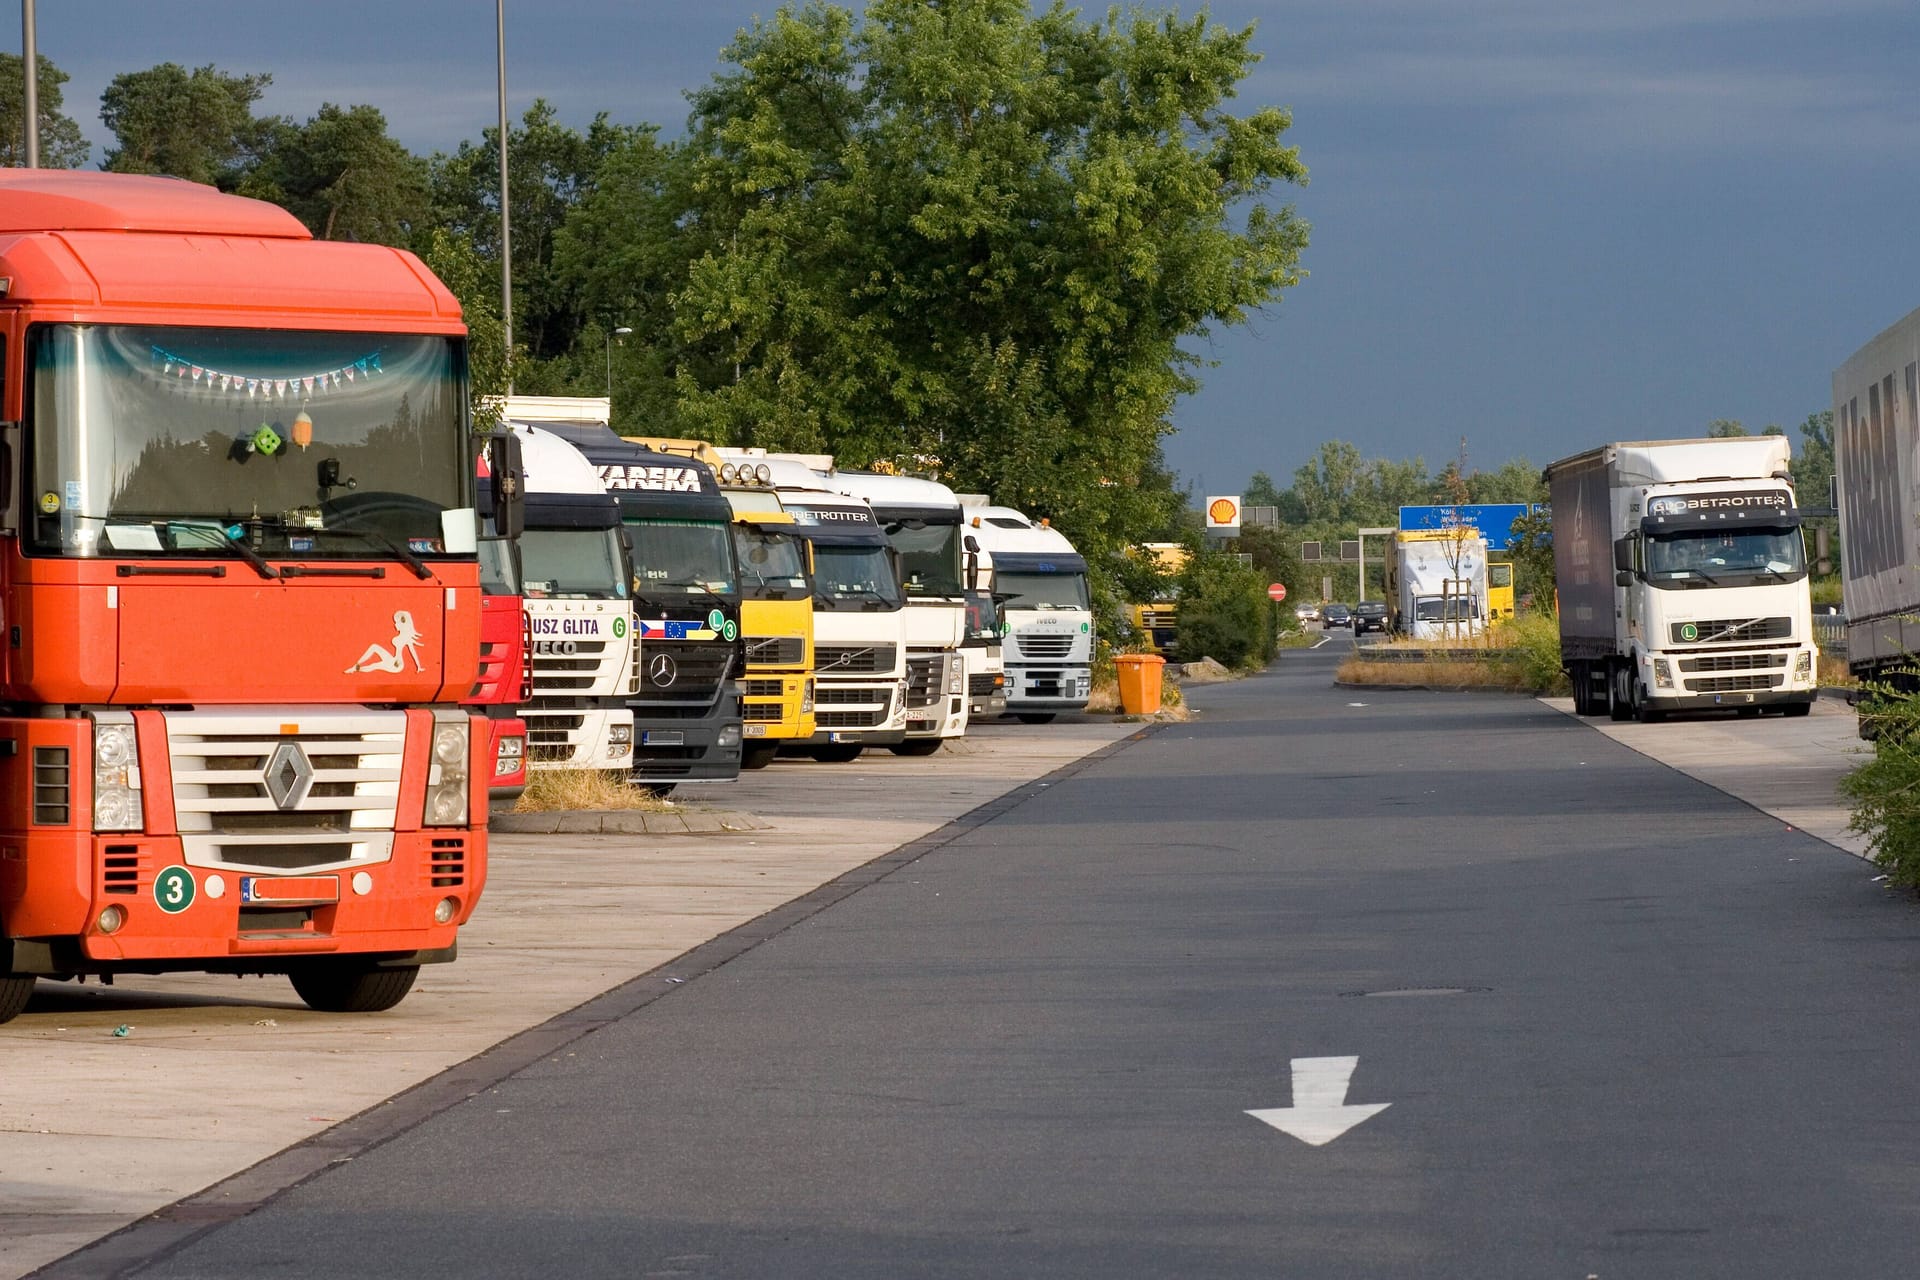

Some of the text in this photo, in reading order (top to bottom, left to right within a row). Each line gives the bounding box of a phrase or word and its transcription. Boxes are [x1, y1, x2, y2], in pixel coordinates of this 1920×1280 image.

[48, 495, 53, 503] 3
[1653, 495, 1786, 512] GLOBETROTTER
[563, 619, 599, 634] GLITA
[713, 613, 720, 627] L
[617, 622, 623, 633] G
[727, 624, 734, 637] 3
[1082, 622, 1088, 632] L
[1685, 628, 1693, 637] L
[532, 641, 577, 655] VECO
[166, 876, 183, 903] 3
